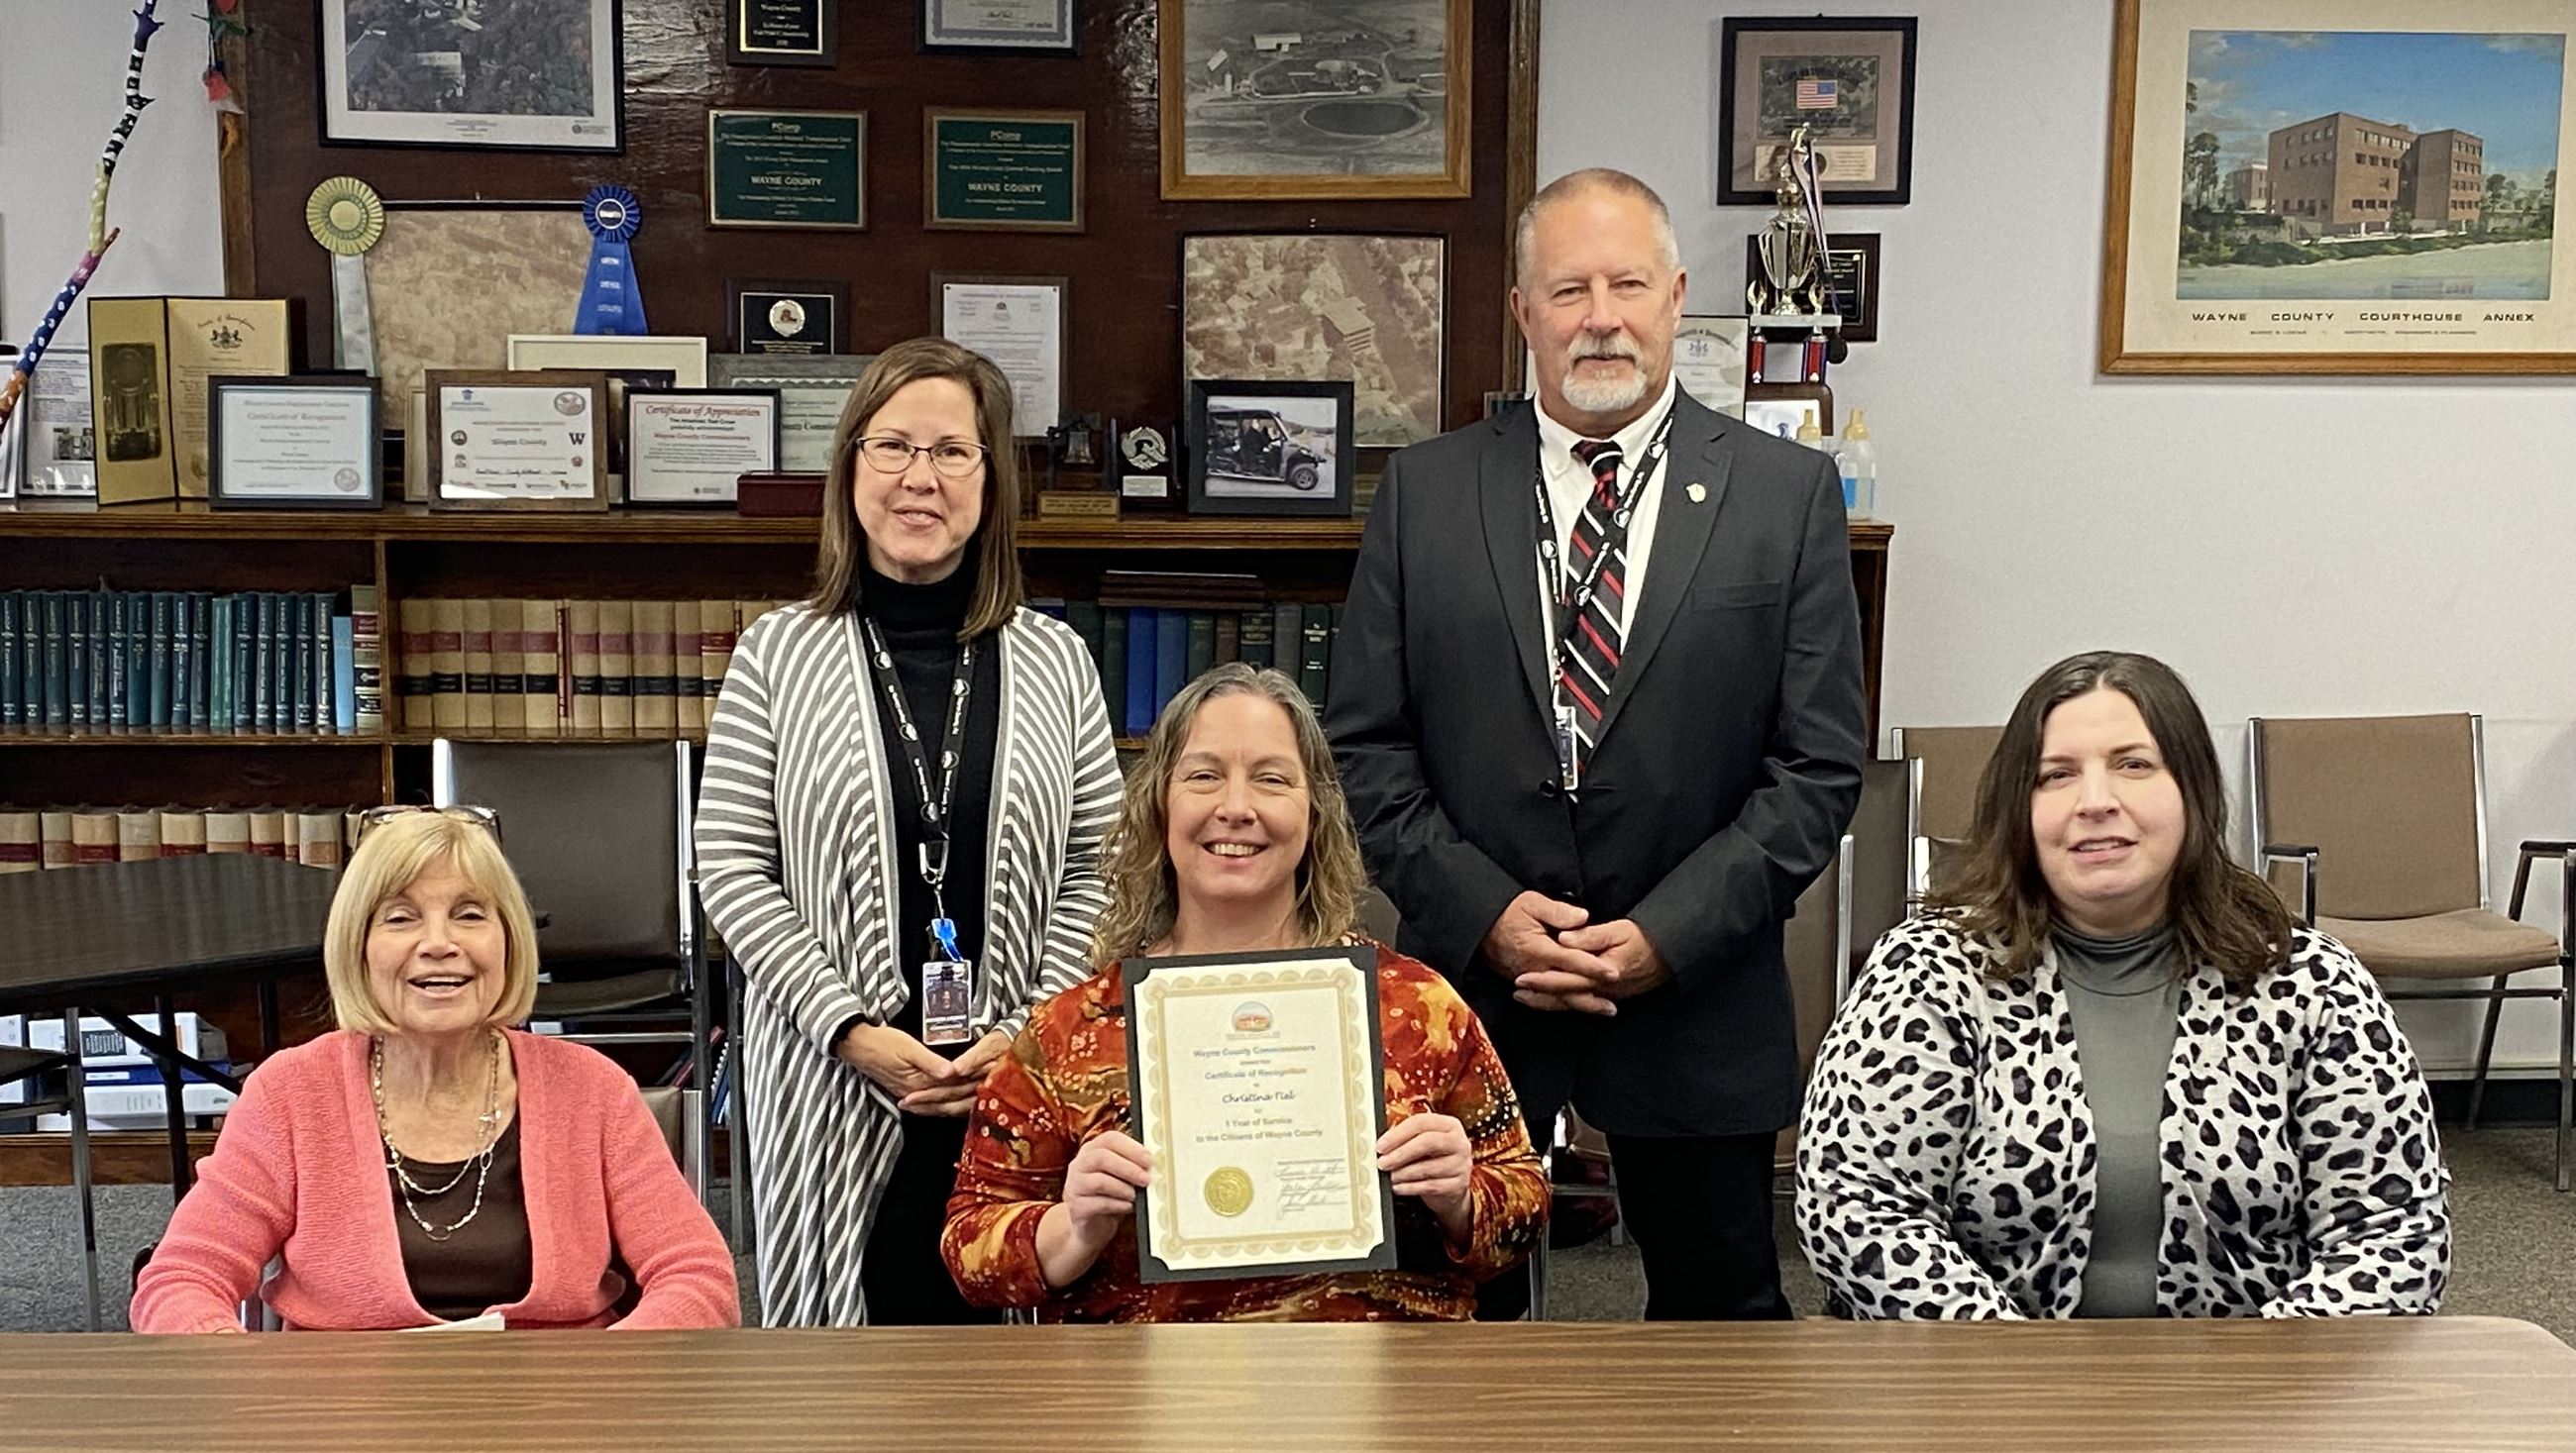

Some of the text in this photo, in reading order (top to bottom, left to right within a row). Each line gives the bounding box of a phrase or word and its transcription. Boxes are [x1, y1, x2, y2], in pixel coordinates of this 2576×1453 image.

[751, 176, 822, 186] WAYNE COUNTY
[968, 183, 1043, 192] WAYNE COUNTY
[2192, 313, 2534, 322] WAYNE COUNTY COURTHOUSE ANNEX
[645, 405, 692, 416] Certificate
[704, 407, 760, 418] Appreciation
[568, 432, 586, 445] W
[1193, 1044, 1316, 1059] Wayne County Commissioners
[1205, 1067, 1307, 1080] Certificate of Recognition
[1222, 1092, 1273, 1104] Christina
[1232, 1119, 1250, 1128] Year
[1252, 1117, 1261, 1126] of
[1263, 1116, 1292, 1126] Service
[1221, 1132, 1253, 1142] Citizens
[1255, 1131, 1263, 1140] of
[1265, 1129, 1292, 1141] Wayne
[1294, 1128, 1323, 1139] County
